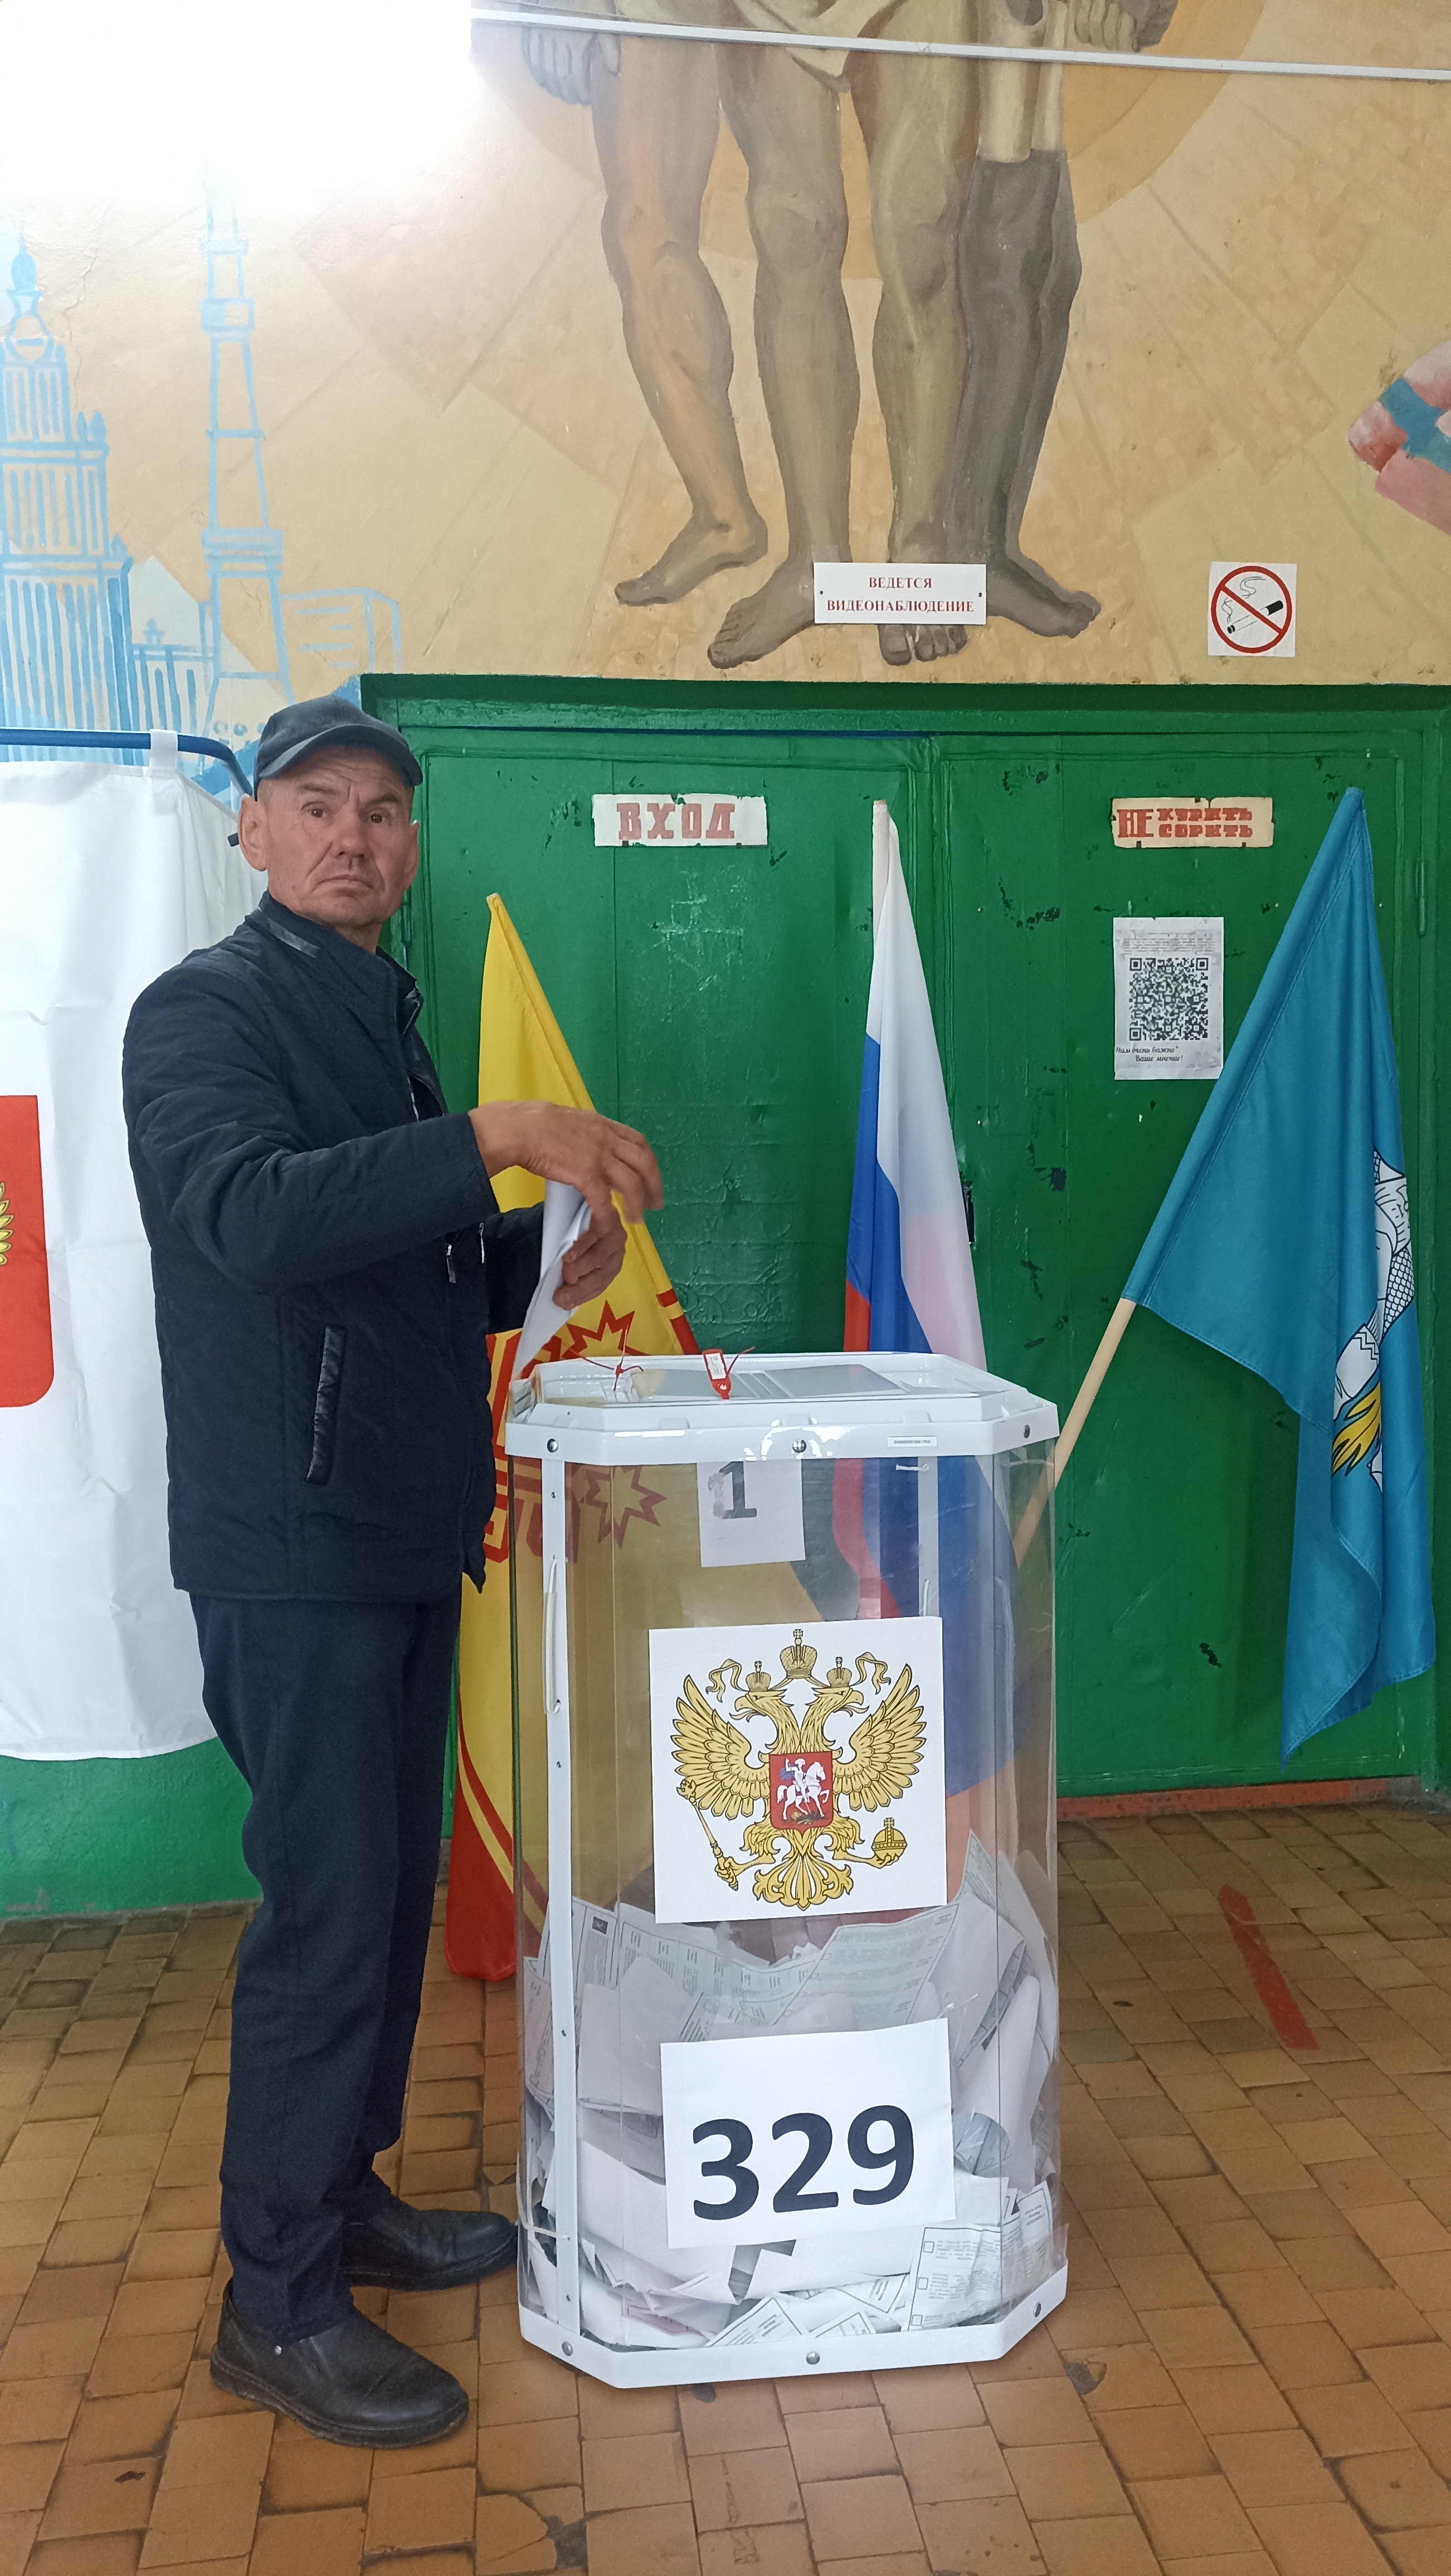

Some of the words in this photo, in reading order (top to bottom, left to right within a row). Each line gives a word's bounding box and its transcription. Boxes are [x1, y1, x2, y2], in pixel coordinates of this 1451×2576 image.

[869, 577, 932, 589] ВЕДЕТСЯ
[827, 600, 974, 613] ВИДЕОНАБЛЮДЕНИЕ
[616, 803, 735, 840] ВХОД
[1117, 809, 1153, 838] НЕ
[1157, 808, 1252, 821] КУРИТЬ
[1159, 824, 1253, 837] СОРИТЬ
[719, 1461, 757, 1520] 1
[693, 2105, 914, 2220] 329
